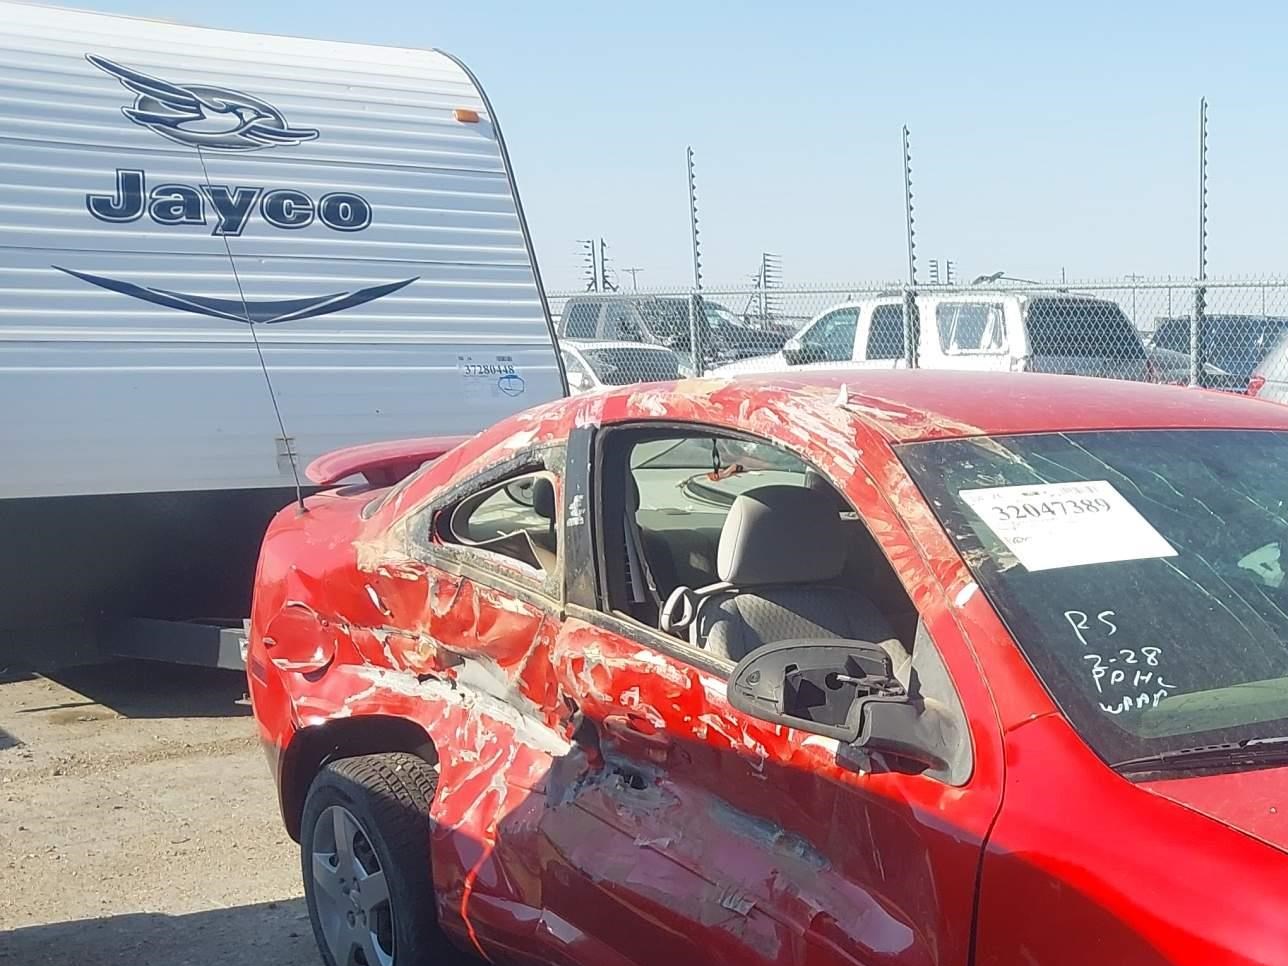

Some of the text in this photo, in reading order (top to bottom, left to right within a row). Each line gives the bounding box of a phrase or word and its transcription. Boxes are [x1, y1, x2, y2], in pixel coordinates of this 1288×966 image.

[86, 168, 373, 236] Jayco
[464, 364, 516, 375] 37280448
[992, 498, 1111, 521] 32047389
